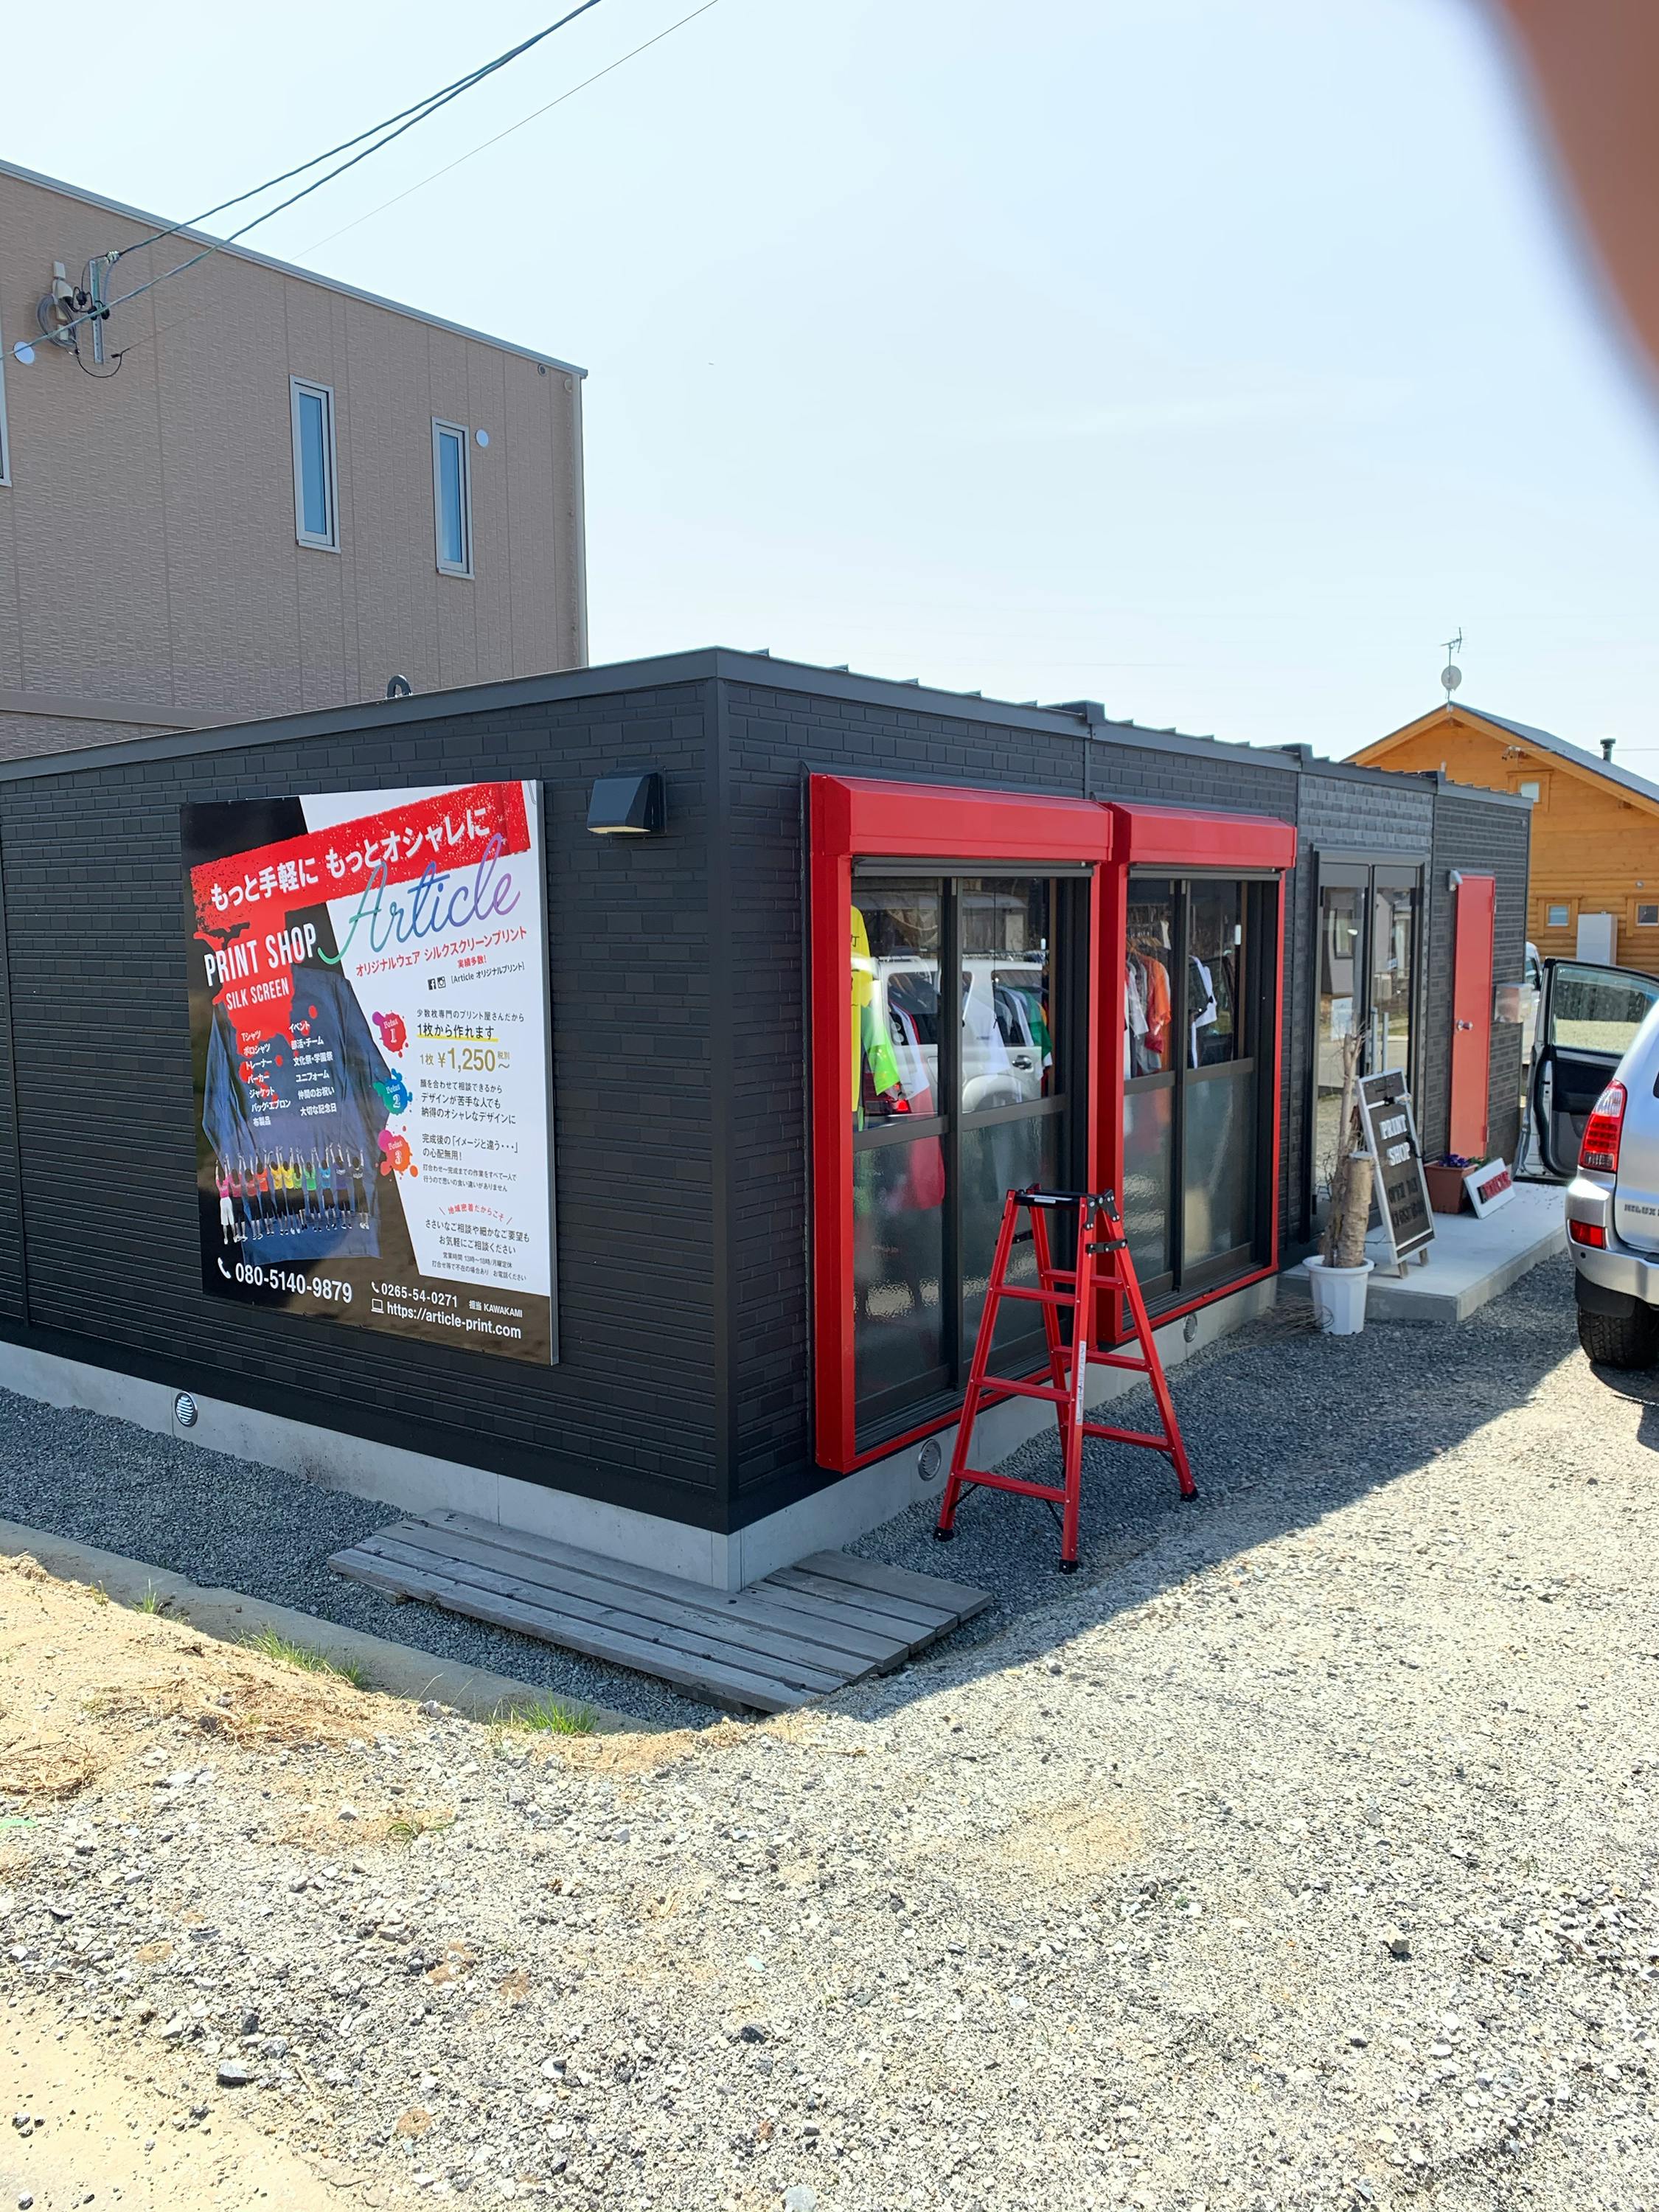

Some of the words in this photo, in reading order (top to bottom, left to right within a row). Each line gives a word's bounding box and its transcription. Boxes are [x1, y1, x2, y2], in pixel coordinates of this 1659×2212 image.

[210, 858, 319, 911] もっと手軽に
[325, 807, 490, 879] もっとオシャレに
[317, 832, 521, 965] Article
[204, 939, 257, 987] PRINT
[265, 922, 317, 969] SHOP
[355, 950, 421, 978] オリジナルウェア
[424, 925, 527, 961] シルクスクリーンプリント
[225, 988, 248, 1011] SILK
[250, 977, 290, 1004] SCREEN
[417, 1008, 524, 1023] 少数枚専門のプリント屋さんだから
[288, 1020, 310, 1033] イベント
[417, 1023, 495, 1040] 1枚から作れます
[240, 1030, 261, 1042] Tシャツ
[389, 1029, 397, 1043] 1
[243, 1043, 271, 1057] ポロシャツ
[245, 1058, 273, 1071] トレーナー
[420, 1054, 434, 1065] 1枚
[295, 1069, 330, 1082] ユニフォーム
[248, 1086, 275, 1099] ジャケット
[420, 1079, 503, 1094] 顔を合わせて相談できるから
[392, 1093, 401, 1108] 2
[420, 1092, 501, 1109] デザインが苦手な人でも
[421, 1107, 516, 1124] 納得のオシャレなデザインに
[1379, 1114, 1408, 1141] PRINT
[394, 1150, 403, 1164] 3
[1386, 1141, 1411, 1166] SHOP
[425, 1219, 530, 1243] ささいなご相談や細かなご要望も
[439, 1236, 516, 1254] お気軽にご相談ください
[234, 1262, 352, 1304] 080-5140-9879
[380, 1282, 458, 1308] 0265-54-0271
[483, 1303, 524, 1318] KAWAKAMI
[386, 1301, 522, 1340] https://article-print.com
